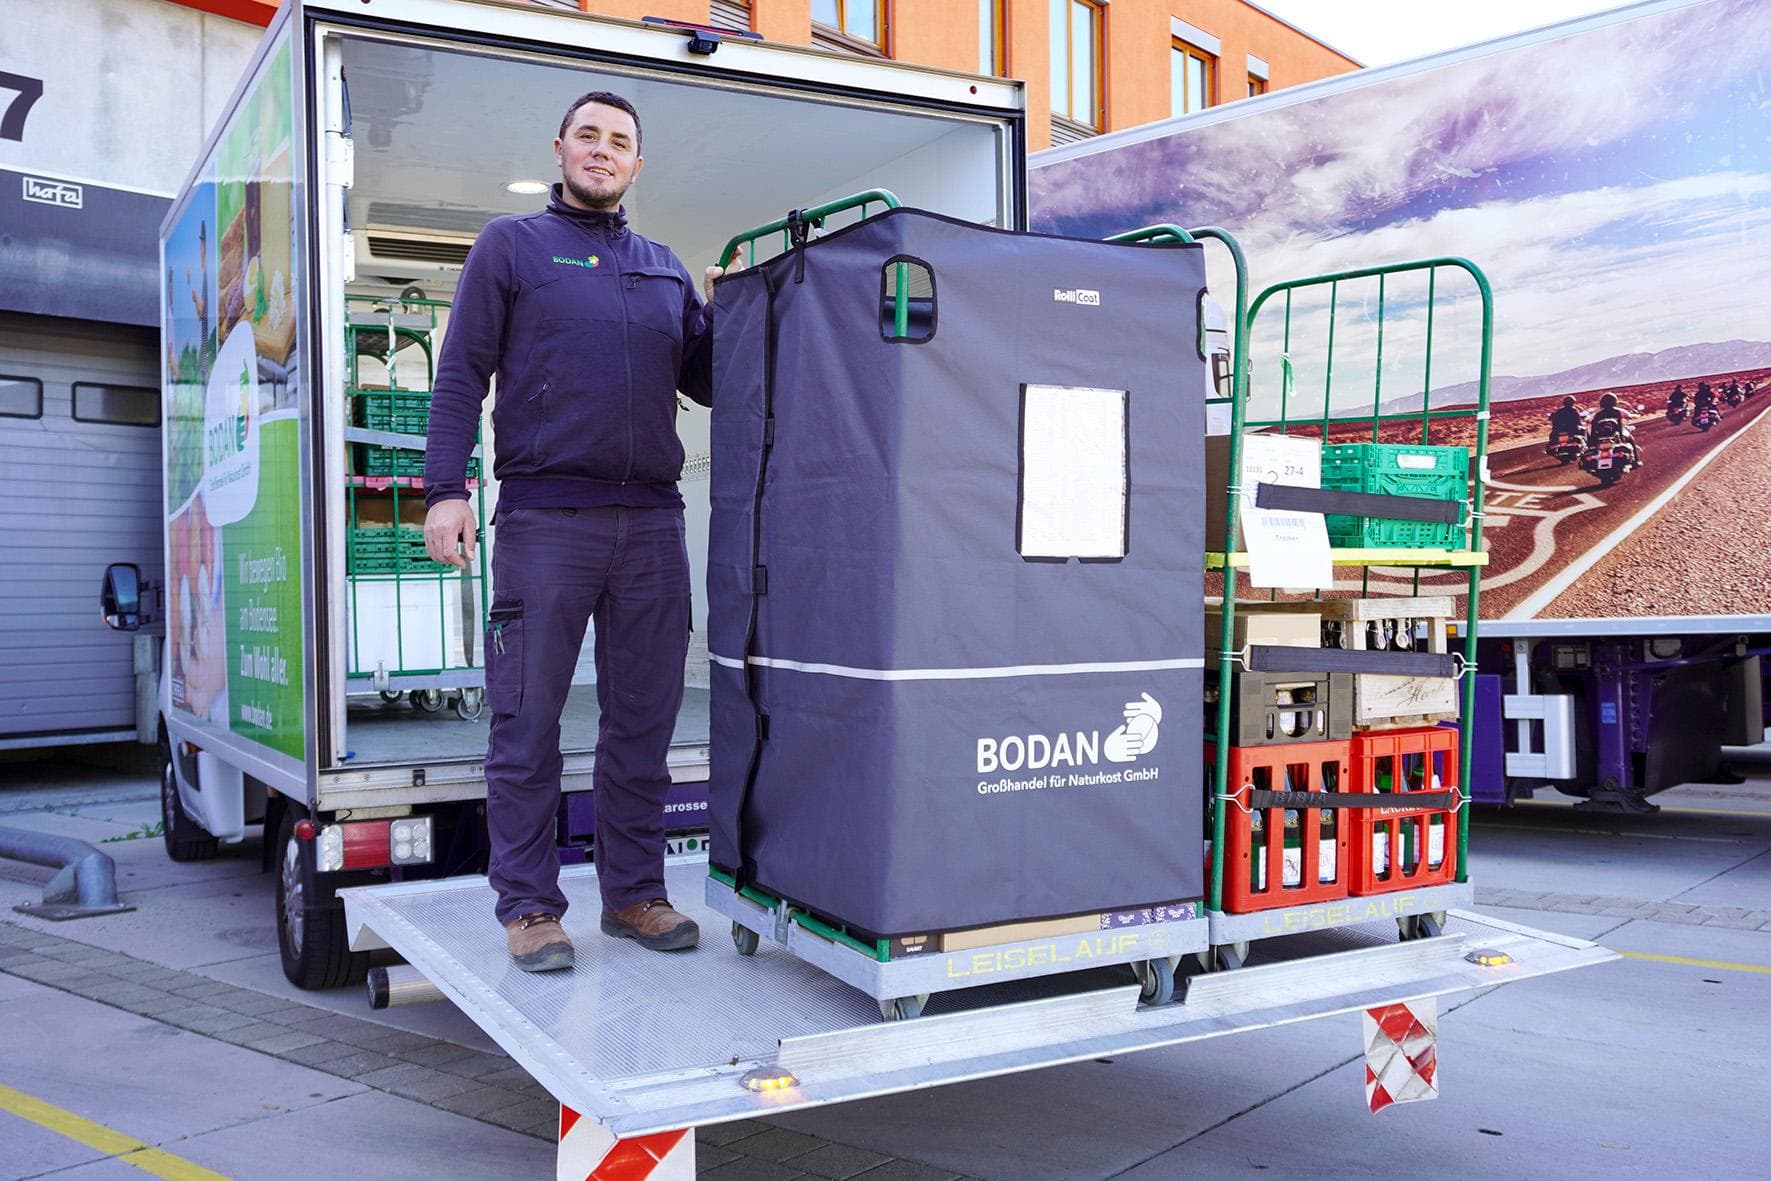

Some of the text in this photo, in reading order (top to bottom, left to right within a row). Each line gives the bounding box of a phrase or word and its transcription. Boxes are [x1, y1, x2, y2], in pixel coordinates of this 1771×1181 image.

[0, 70, 44, 142] 7
[552, 256, 585, 267] BODAN
[977, 730, 1099, 773] BODAN
[977, 768, 1159, 795] Großhandel für Naturkost GmbH
[1263, 895, 1415, 934] LEISELAUF
[946, 933, 1140, 979] LEISELAUF
